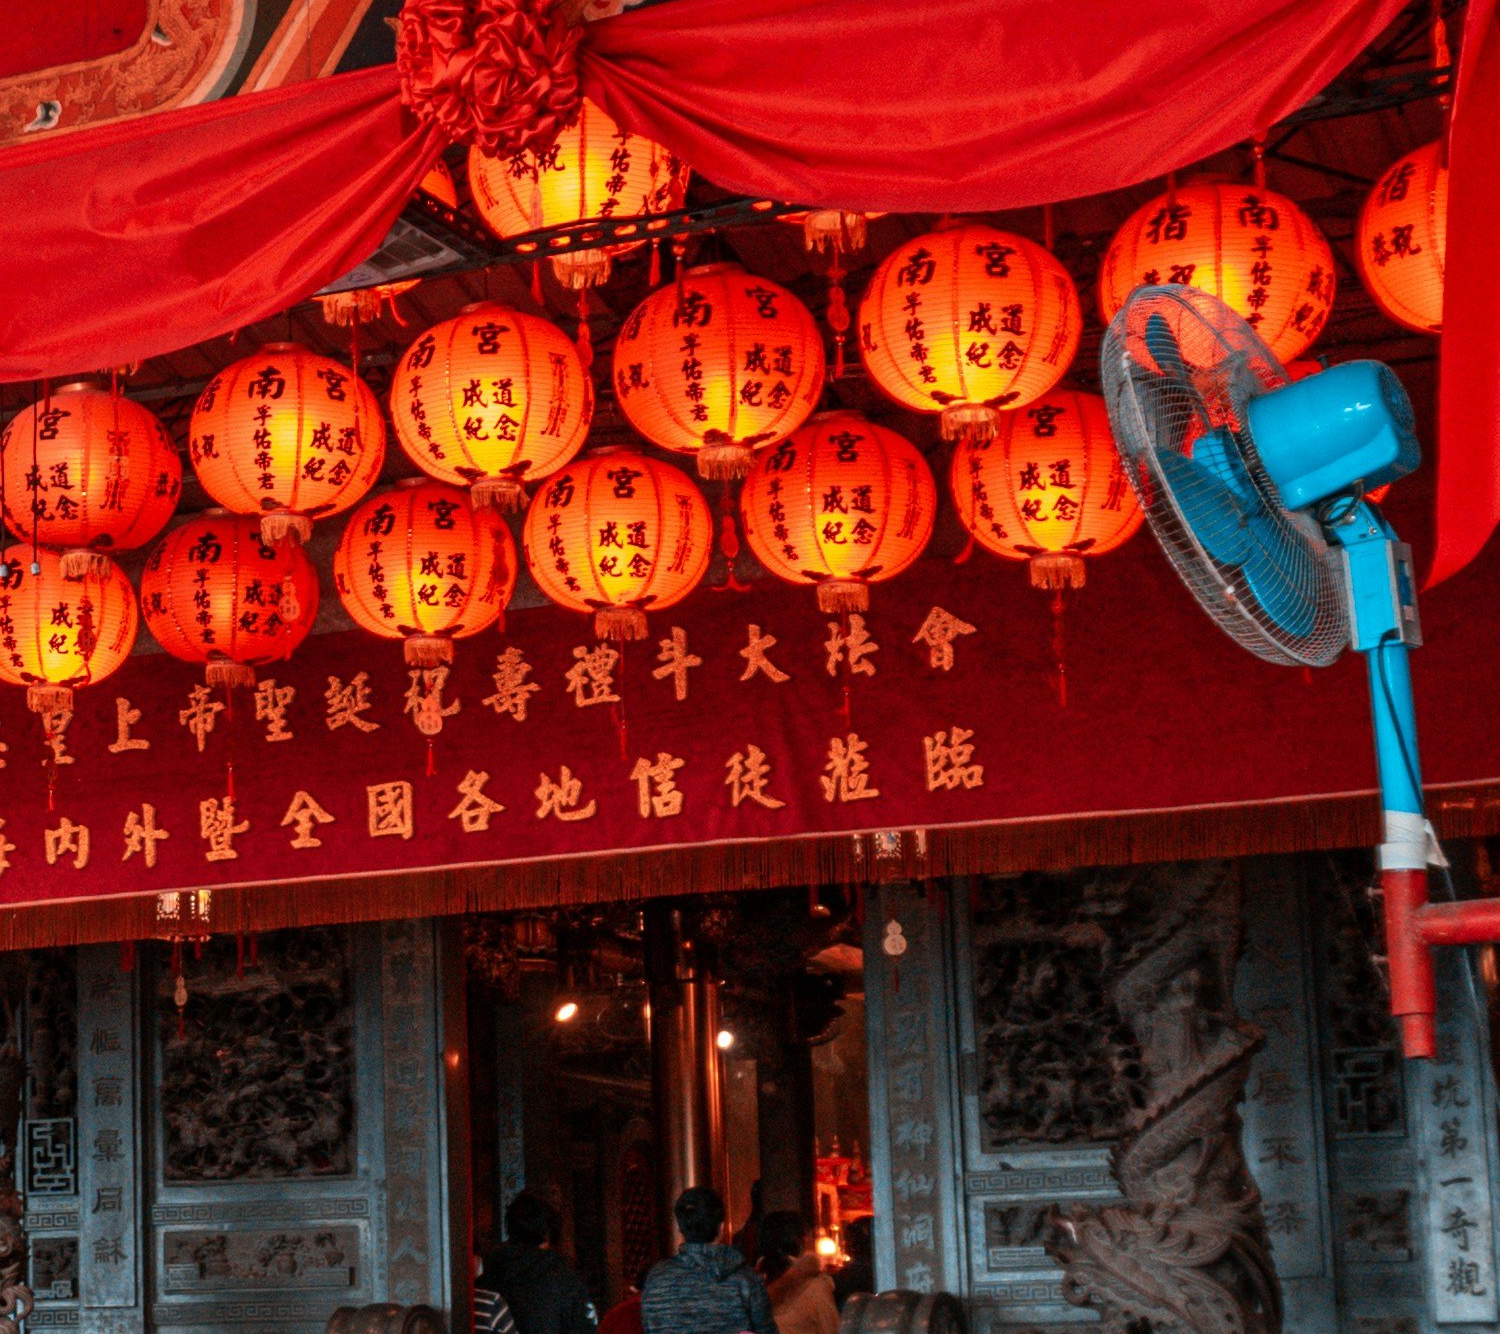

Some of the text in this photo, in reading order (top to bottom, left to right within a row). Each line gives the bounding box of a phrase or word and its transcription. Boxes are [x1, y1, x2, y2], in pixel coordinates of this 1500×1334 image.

[507, 142, 566, 179] 恭祝
[967, 301, 1025, 337] 成道
[902, 292, 937, 384] 孚佑帝君
[745, 341, 796, 374] 成道
[965, 340, 1025, 369] 紀念
[461, 378, 519, 409] 成道
[680, 335, 707, 422] 孚佑帝君
[738, 379, 791, 410] 紀念
[409, 375, 445, 461] 孚佑帝君
[463, 414, 520, 442] 紀念
[252, 404, 276, 490] 孚佑帝君
[310, 421, 357, 455] 成道
[302, 458, 352, 486] 紀念
[1019, 462, 1071, 492] 成道
[822, 484, 874, 514] 成道
[1020, 495, 1079, 522] 紀念
[599, 521, 649, 550] 成道
[822, 516, 874, 545] 紀念
[599, 555, 651, 579] 紀念
